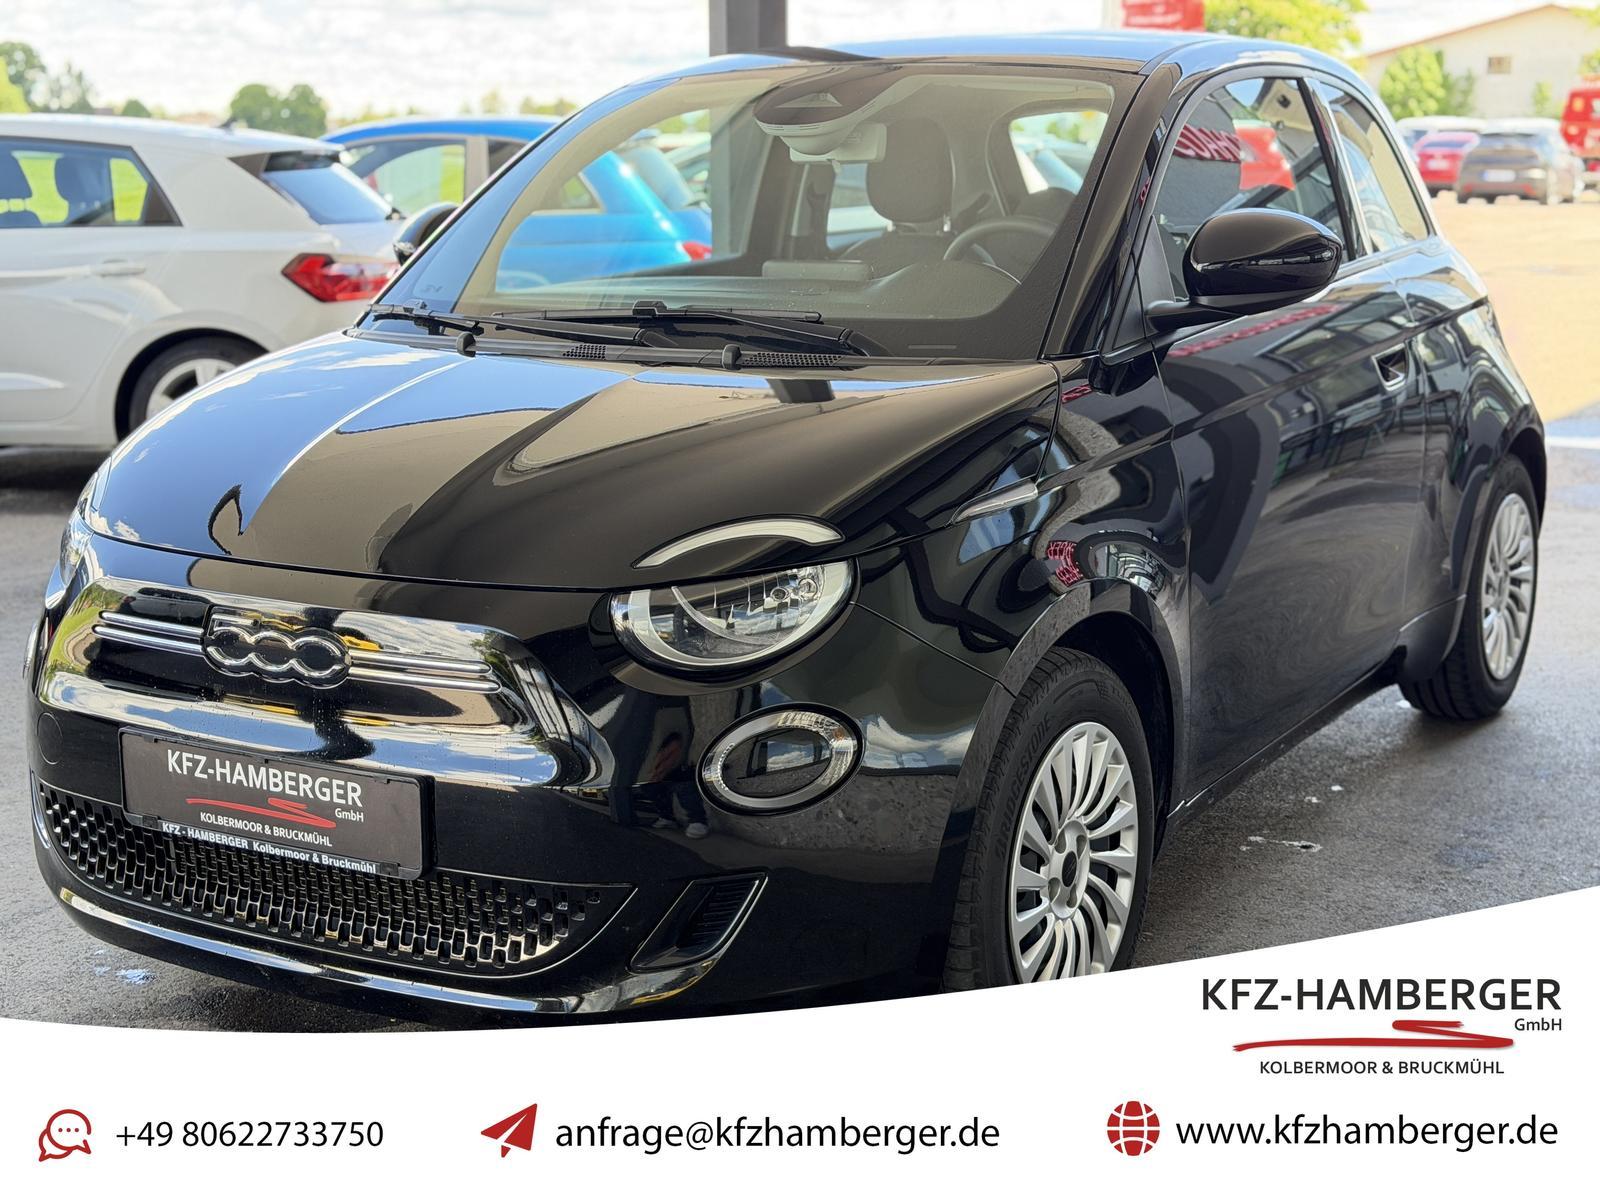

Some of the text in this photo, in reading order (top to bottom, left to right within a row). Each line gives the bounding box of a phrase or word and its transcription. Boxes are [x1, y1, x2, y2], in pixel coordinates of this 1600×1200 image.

[206, 613, 347, 678] 500
[166, 748, 364, 808] KFZ-HAMBERGER
[199, 811, 333, 848] KOLBERMOOR & BRUCKMÜHL
[334, 807, 365, 823] GmbH
[161, 822, 181, 836] KFZ
[187, 827, 249, 850] HAMBERGER
[252, 840, 310, 863] Kolbermoor
[311, 853, 320, 863] &
[321, 854, 377, 874] Bruckmühl
